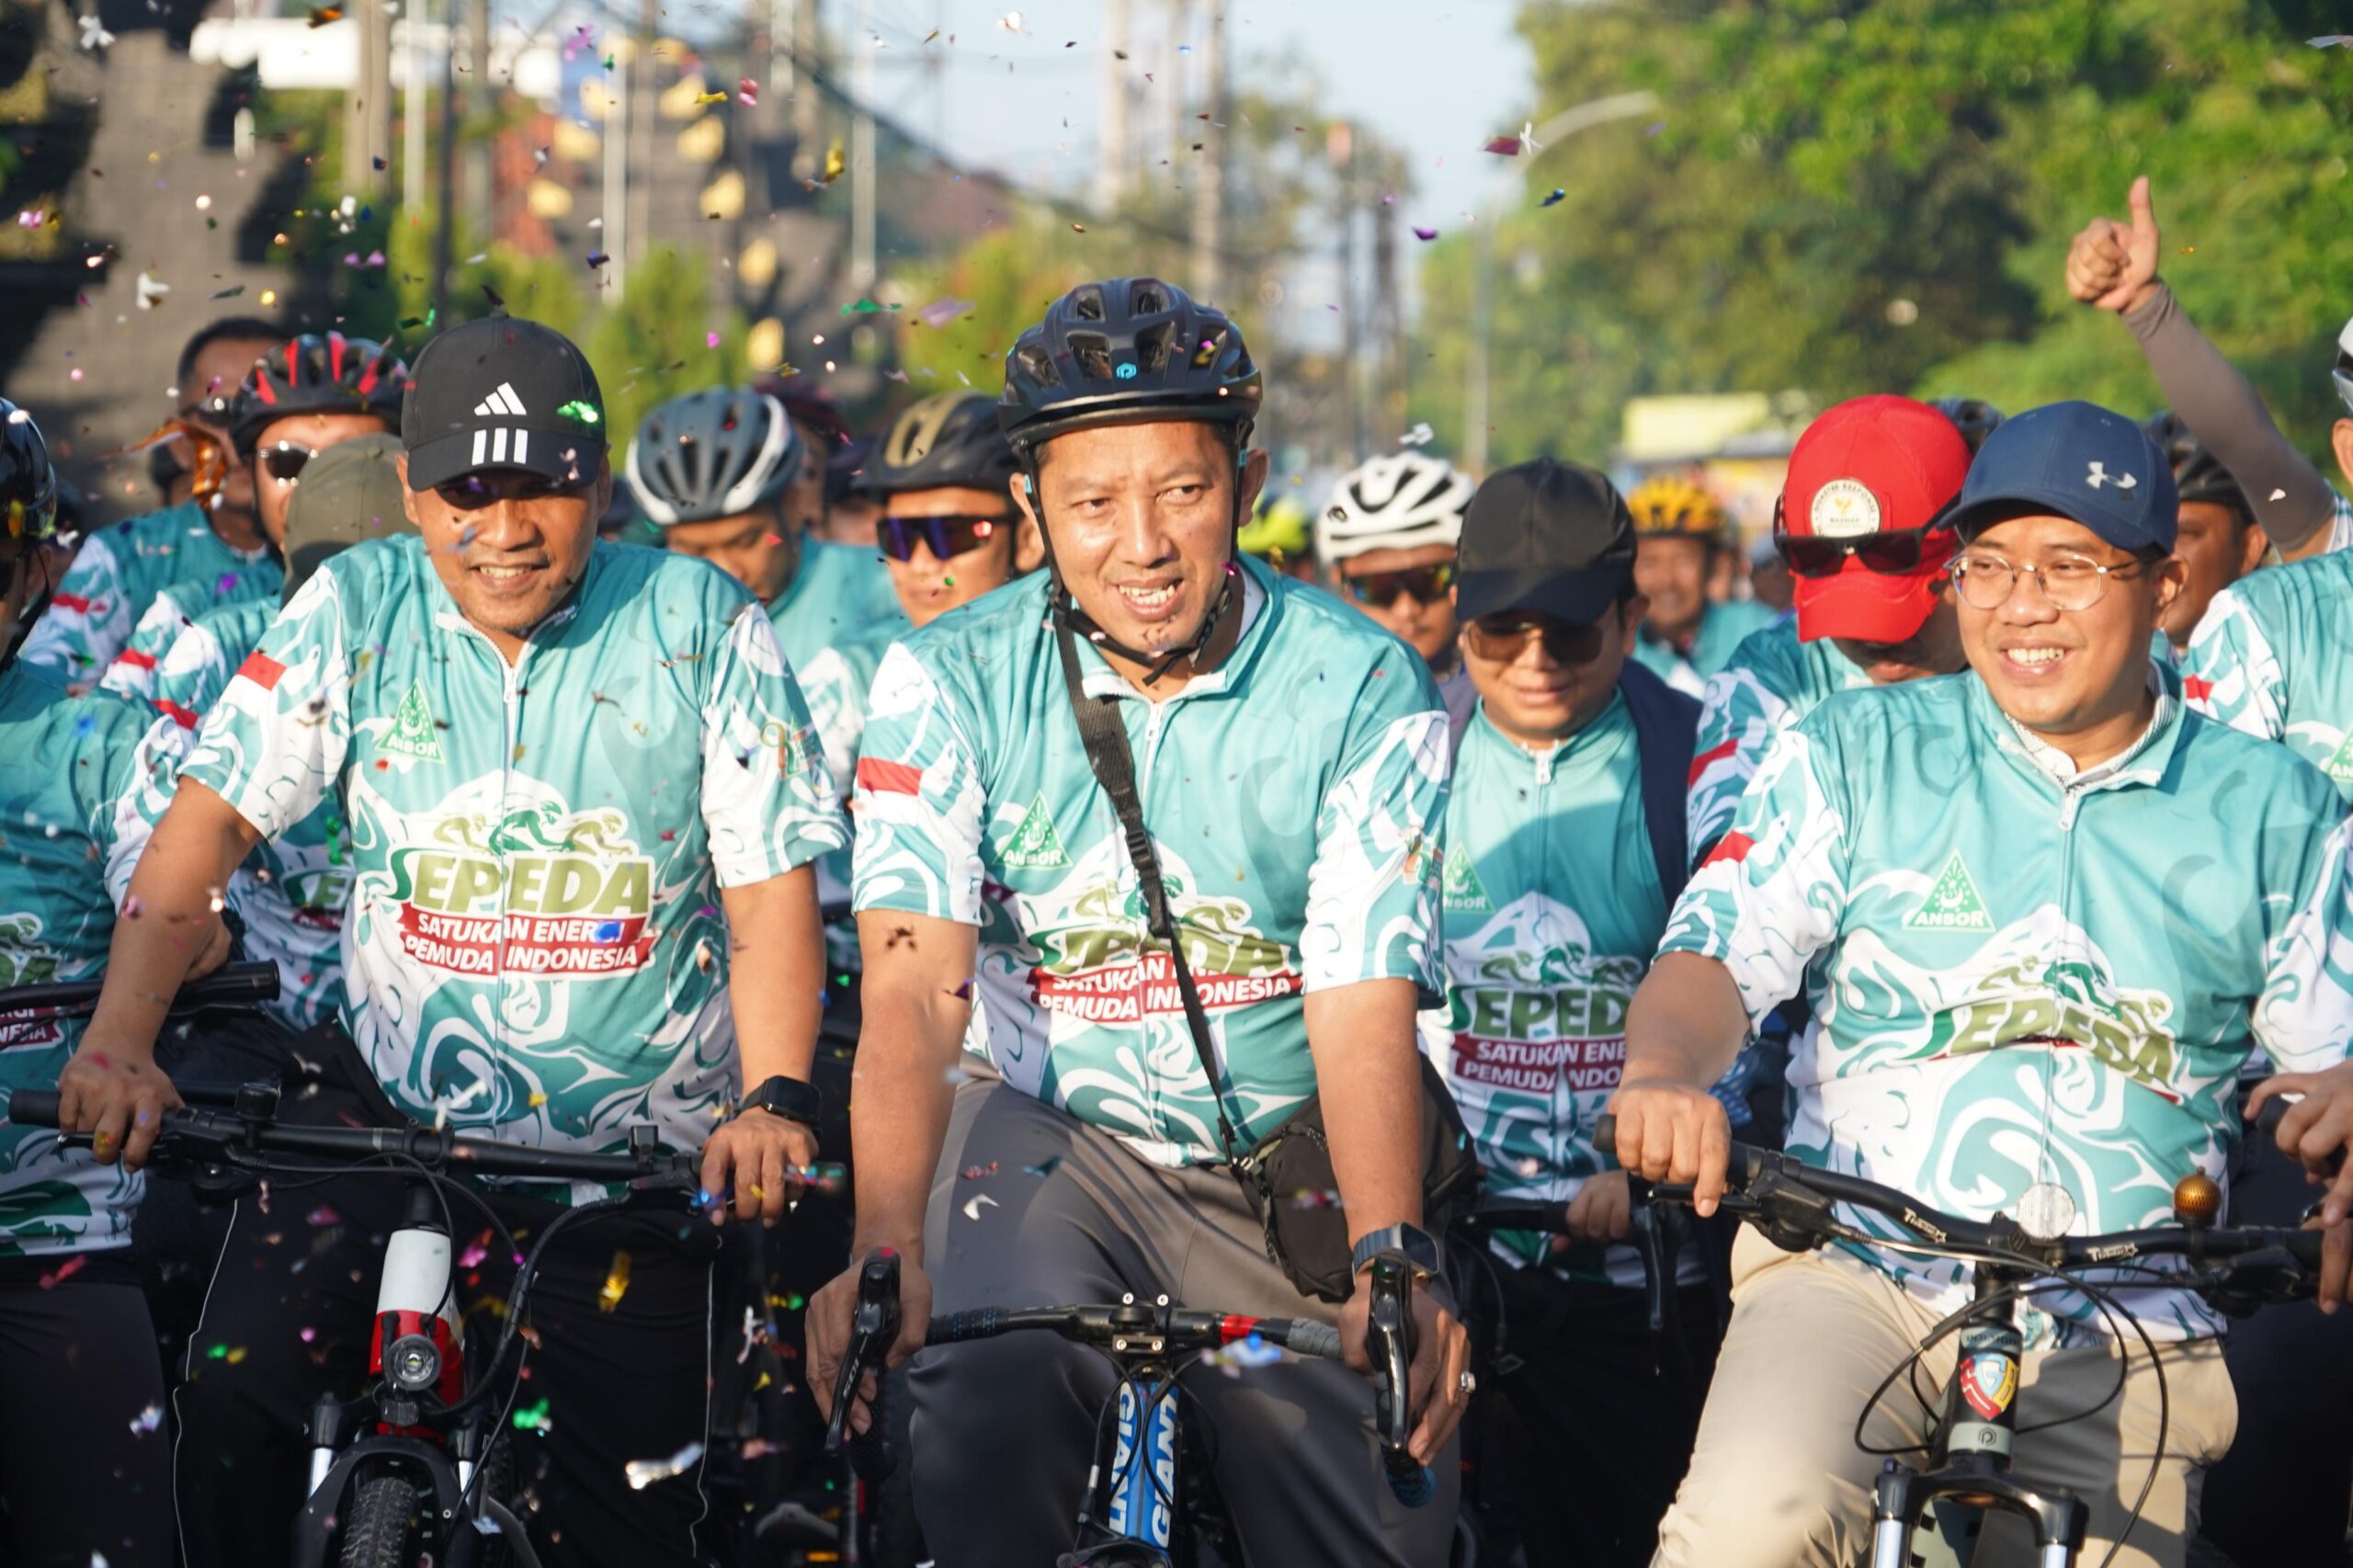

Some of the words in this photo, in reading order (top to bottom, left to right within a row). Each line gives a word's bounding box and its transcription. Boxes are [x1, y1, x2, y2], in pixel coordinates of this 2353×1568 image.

[1004, 848, 1062, 866] ANSOR
[388, 847, 650, 915] SEPEDA
[1443, 896, 1486, 909] NSOR
[1914, 909, 1984, 927] ANSOR
[418, 915, 529, 944] SATUKAN
[533, 919, 625, 943] ENERI
[405, 937, 494, 972] PEMUDA
[506, 945, 638, 971] INDONESIA
[1051, 958, 1165, 993] SATUKAN
[1040, 994, 1139, 1020] PEMUDA
[1440, 984, 1631, 1040] SEPED
[1477, 1040, 1579, 1066] SATUKAN
[1108, 1381, 1136, 1536] GIANT
[1152, 1392, 1177, 1549] GIANT
